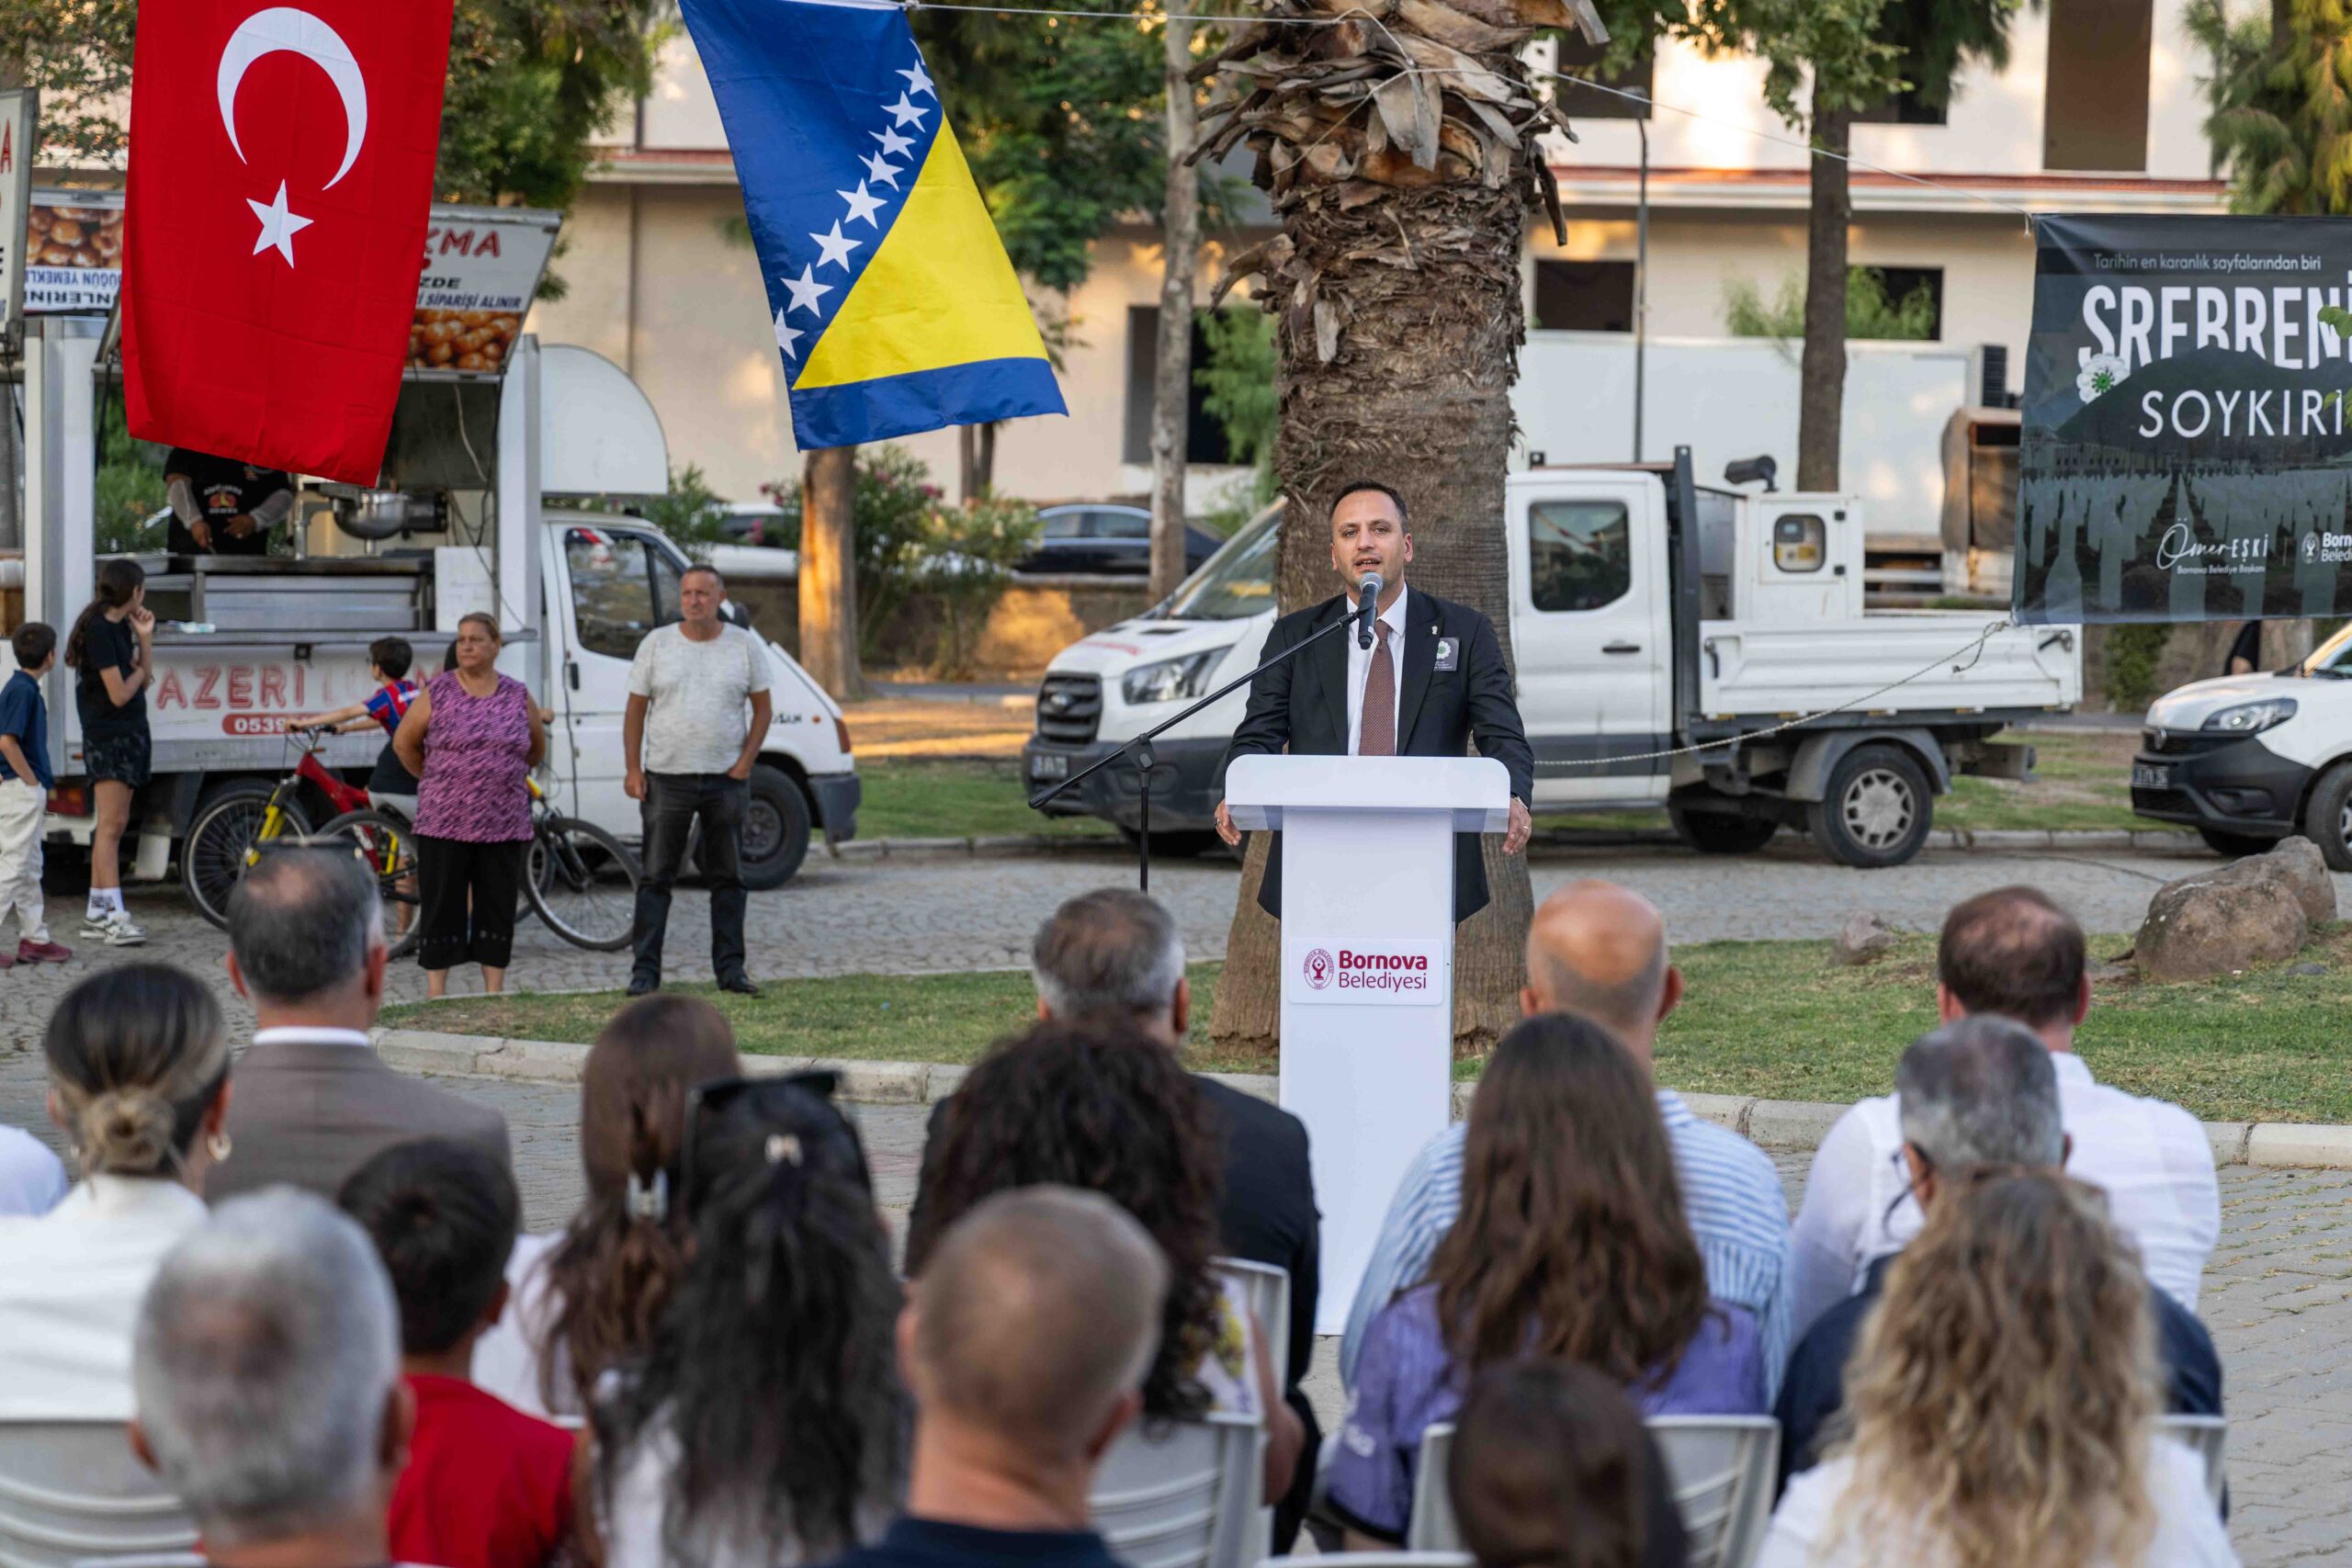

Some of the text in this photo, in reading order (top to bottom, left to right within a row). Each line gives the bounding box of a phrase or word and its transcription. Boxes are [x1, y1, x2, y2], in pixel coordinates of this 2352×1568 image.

[2094, 253, 2322, 274] Tarihin en karanlık sayfalarından biri
[480, 295, 522, 309] ALINIR
[2156, 517, 2232, 570] Ömer
[2231, 533, 2268, 563] EŞKİ
[1339, 950, 1428, 970] Bornova
[1339, 971, 1427, 993] Belediyesi
